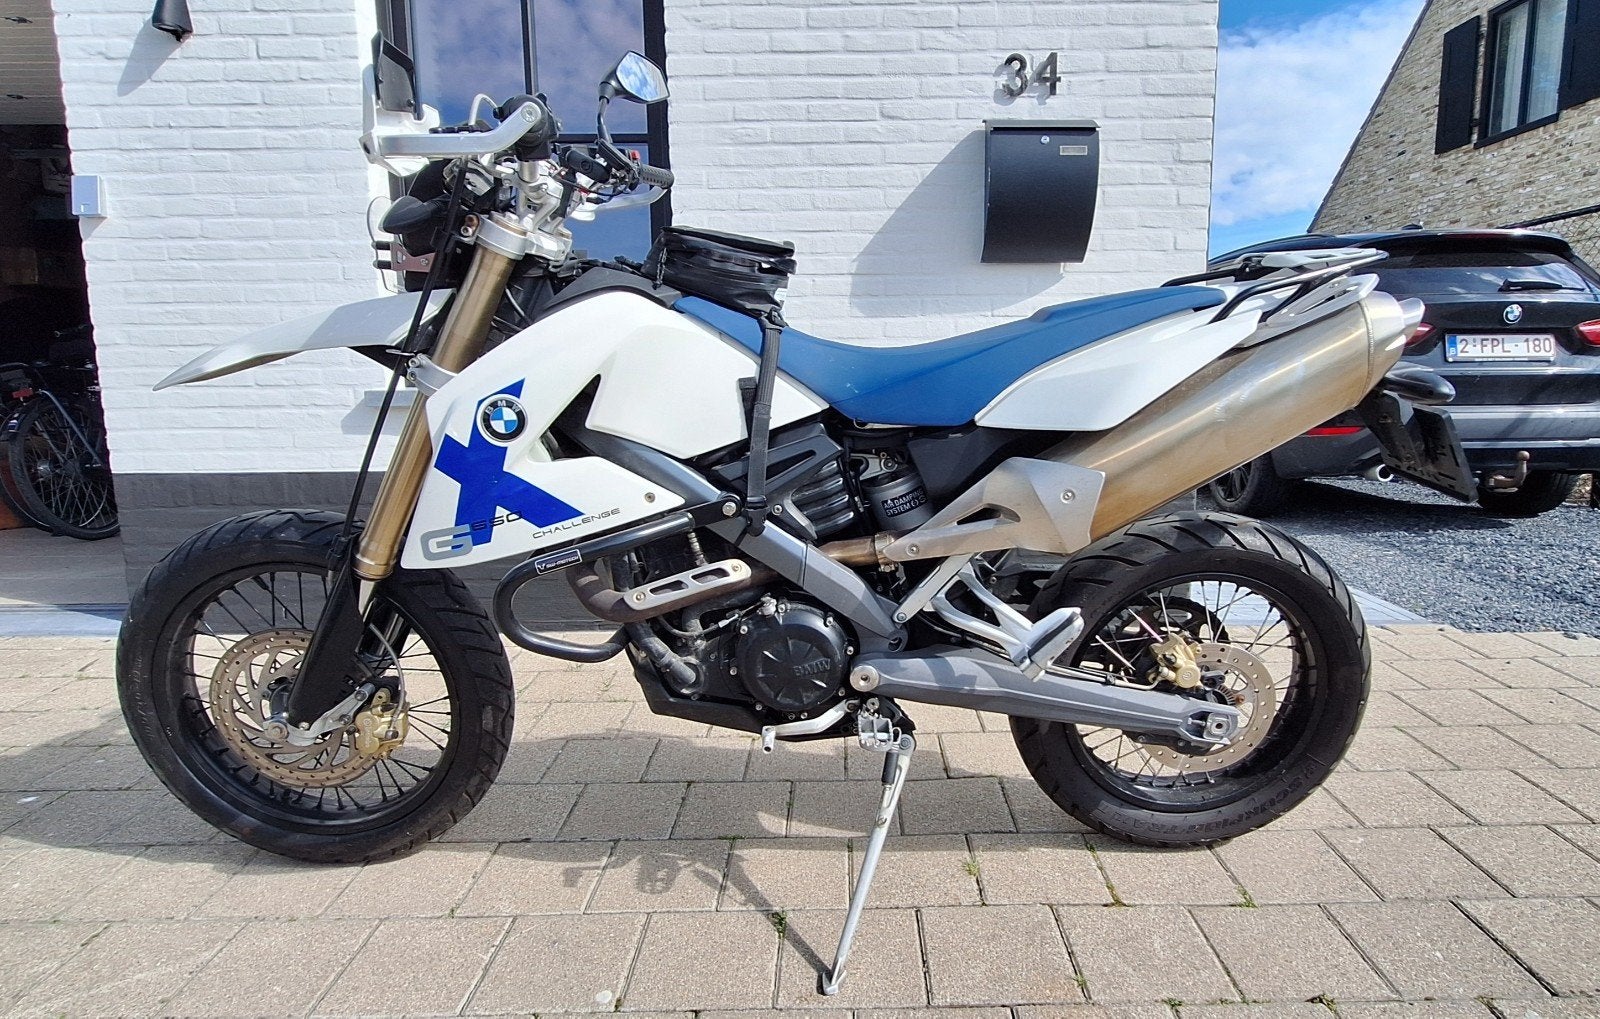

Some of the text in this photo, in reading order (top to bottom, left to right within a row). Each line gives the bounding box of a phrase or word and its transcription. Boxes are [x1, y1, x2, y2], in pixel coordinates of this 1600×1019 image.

[1002, 51, 1062, 97] 34
[485, 399, 521, 414] BMW
[894, 487, 924, 506] DAMPING
[886, 502, 911, 516] SYSTEM
[532, 507, 621, 539] CHALLENGE
[793, 657, 831, 676] BMW
